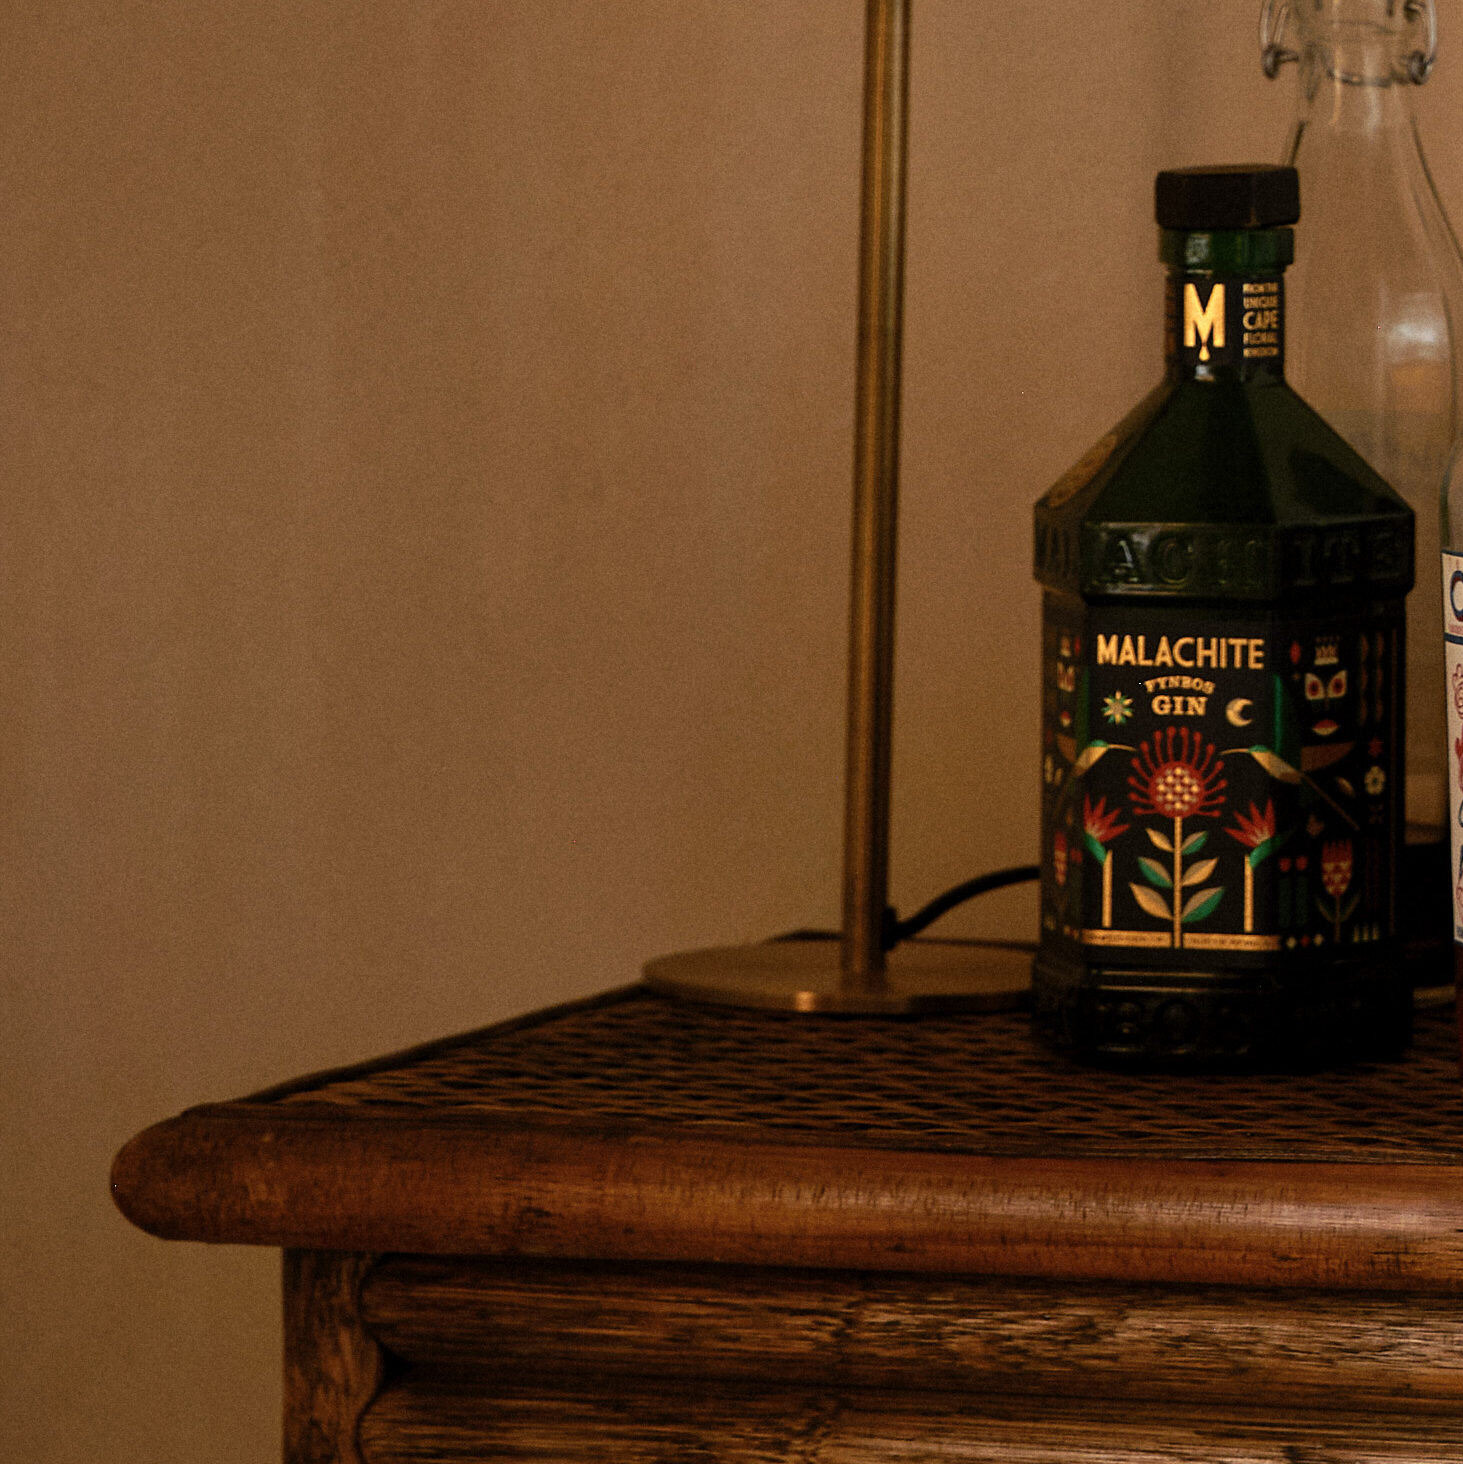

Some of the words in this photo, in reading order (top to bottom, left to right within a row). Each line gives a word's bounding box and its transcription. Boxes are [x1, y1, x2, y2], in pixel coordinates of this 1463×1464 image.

[1243, 310, 1279, 330] CAPE
[1096, 633, 1265, 669] MALACHITE
[1144, 675, 1216, 694] FYNBOS
[1151, 694, 1208, 716] GIN
